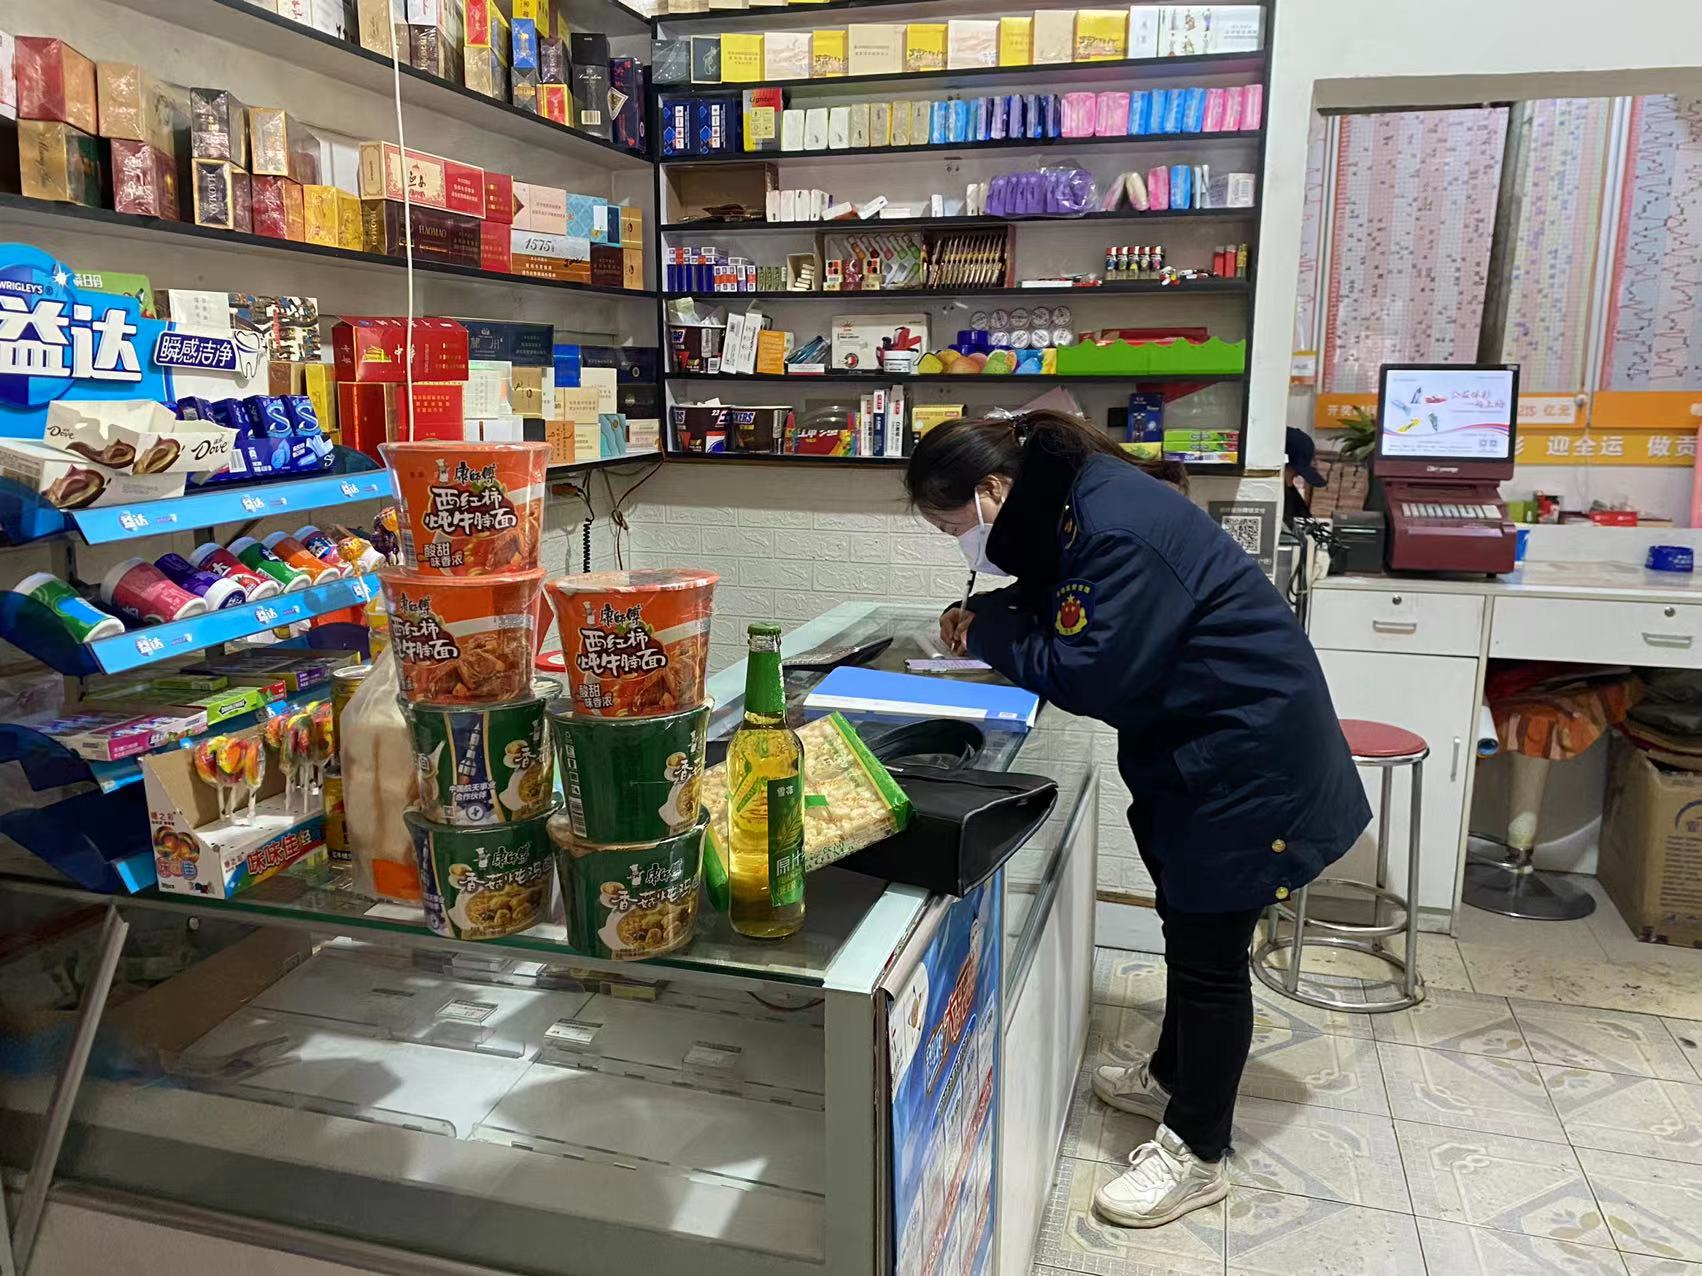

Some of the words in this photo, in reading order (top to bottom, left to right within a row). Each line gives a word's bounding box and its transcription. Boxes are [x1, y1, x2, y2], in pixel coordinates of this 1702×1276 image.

[206, 172, 219, 216] HAOMAO
[0, 295, 143, 382] 益达
[158, 335, 233, 367] 瞬感洁净
[47, 425, 75, 440] Dove
[191, 440, 228, 461] Dove
[1546, 435, 1624, 457] 迎全运
[431, 486, 502, 512] 西红柿
[425, 508, 518, 535] 炖牛腩面
[424, 542, 452, 559] 酸甜
[430, 551, 465, 568] 味香浓
[581, 629, 649, 651] 西红柿
[577, 649, 668, 678] 炖牛腩面
[579, 683, 601, 698] 酸甜
[584, 692, 614, 709] 味香浓
